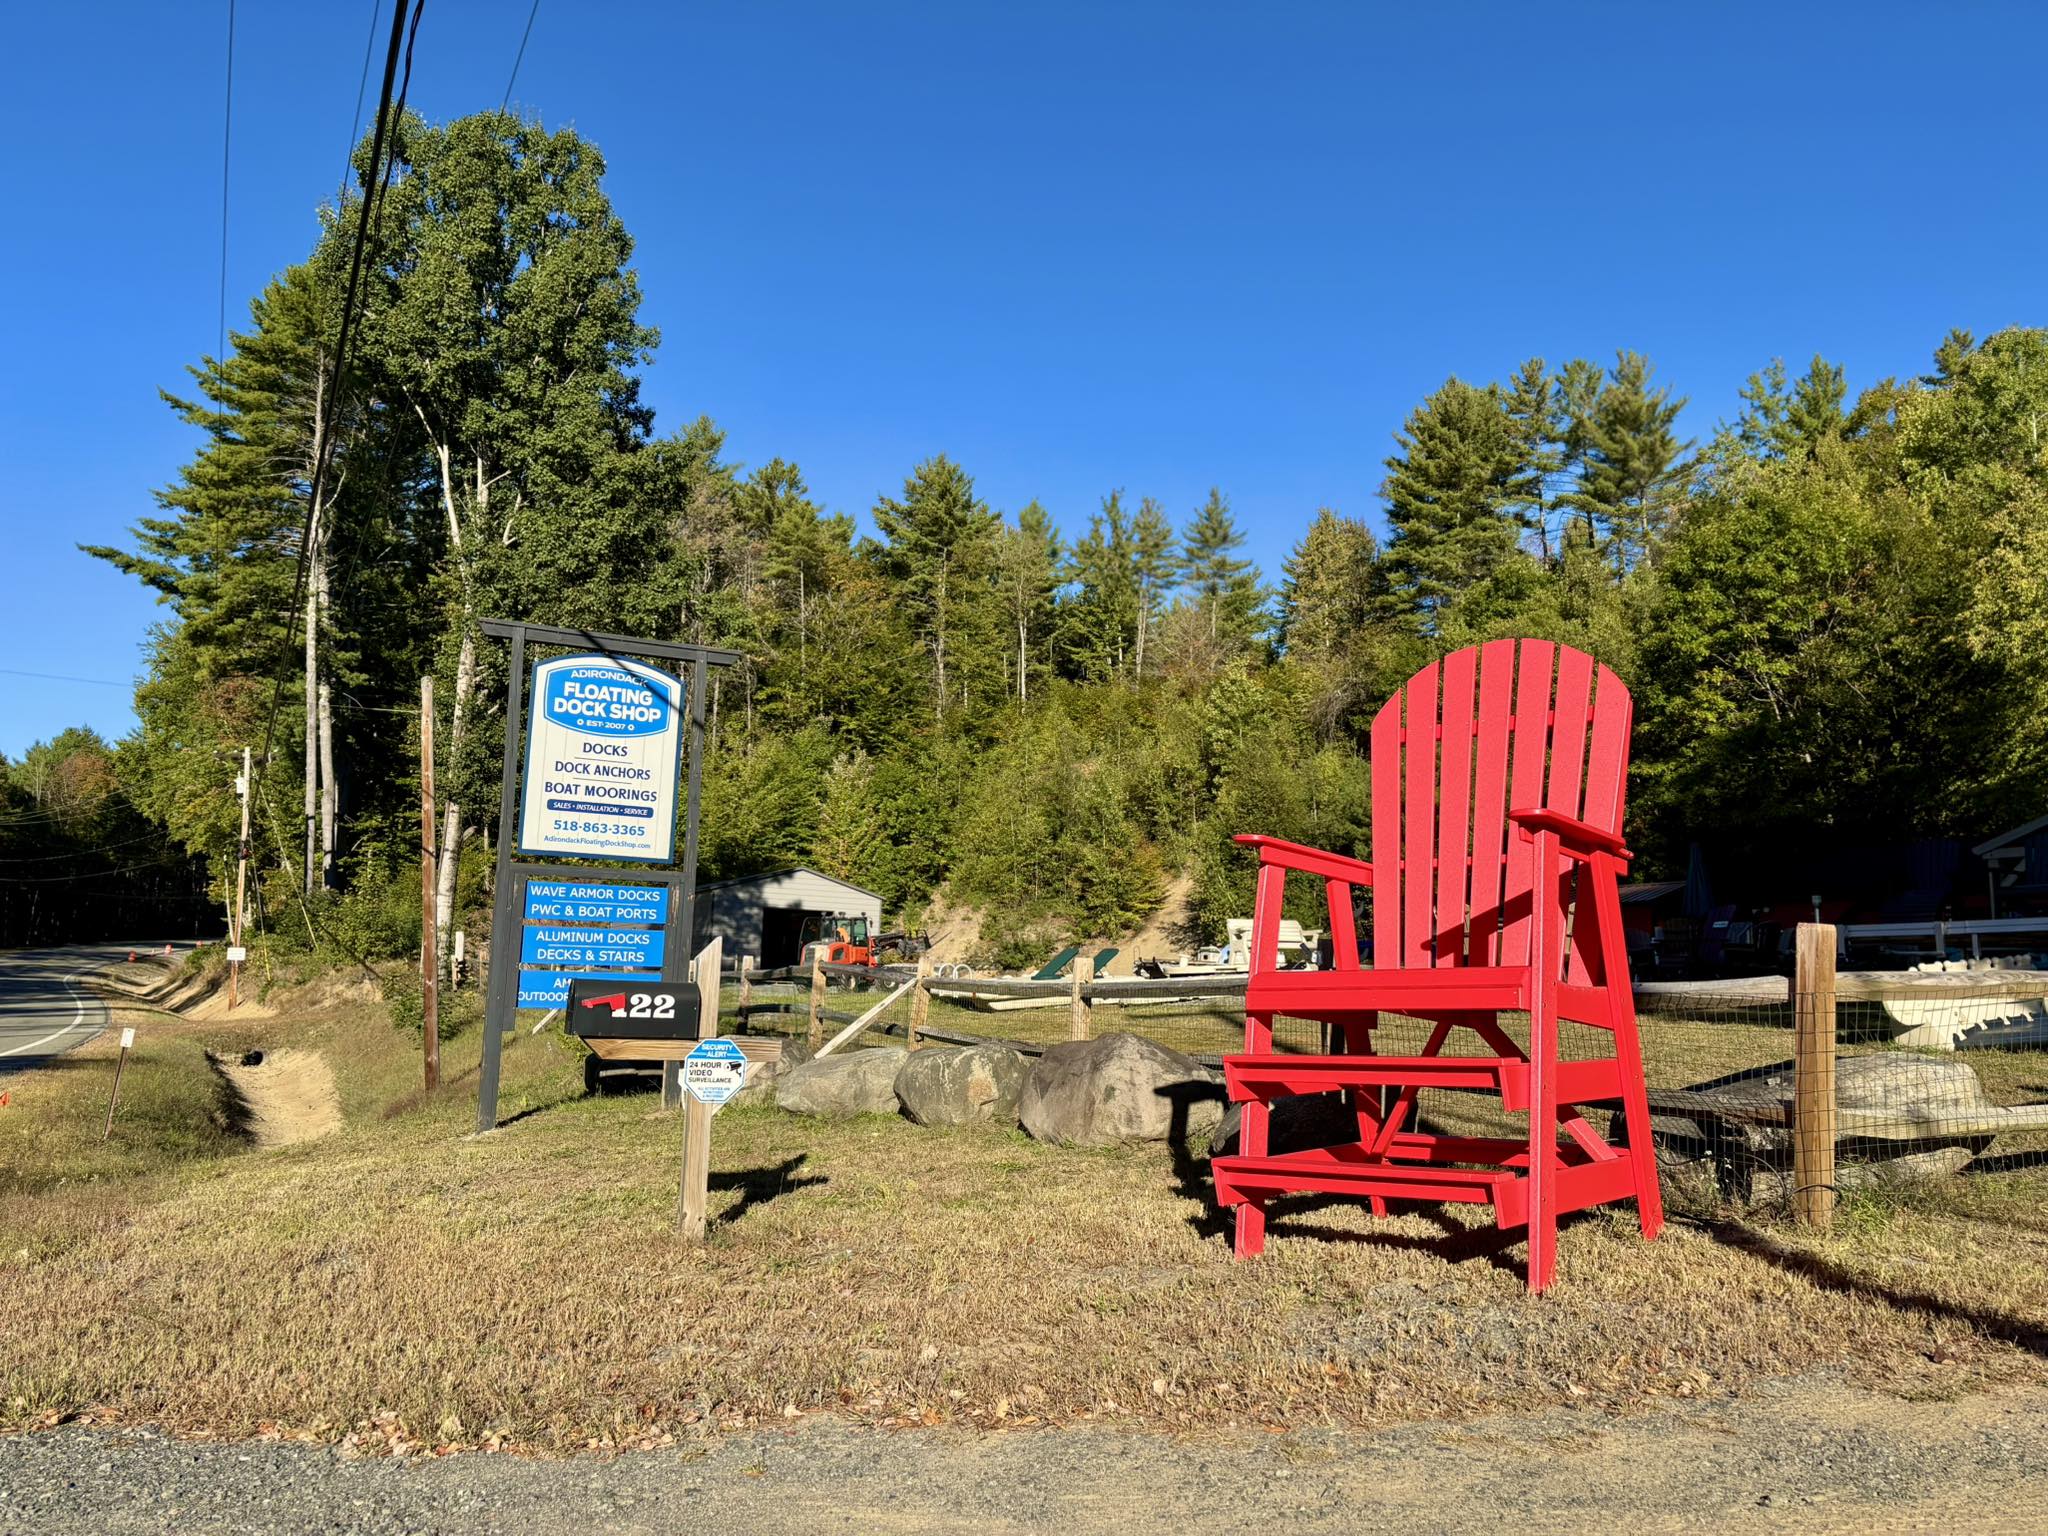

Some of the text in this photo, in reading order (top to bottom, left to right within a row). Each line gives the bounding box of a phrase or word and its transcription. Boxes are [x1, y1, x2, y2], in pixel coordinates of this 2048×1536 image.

[571, 669, 648, 687] ADIRONDACK
[564, 681, 653, 705] FLOATING
[554, 698, 662, 723] DOCK SHOP
[583, 742, 628, 757] DOCKS
[555, 761, 651, 780] DOCK ANCHORS
[544, 781, 657, 802] BOAT MOORINGS
[576, 804, 619, 813] INSTALLATION
[623, 808, 648, 816] SERVICE
[544, 835, 651, 849] AdirondackFloatingDockShop.com
[530, 885, 660, 901] WAVE ARMOR DOCKS
[531, 904, 657, 920] PWC & BOAT PORTS
[536, 931, 650, 945] ALUMINUM DOCKS
[537, 949, 644, 962] DECKS & STAIRS
